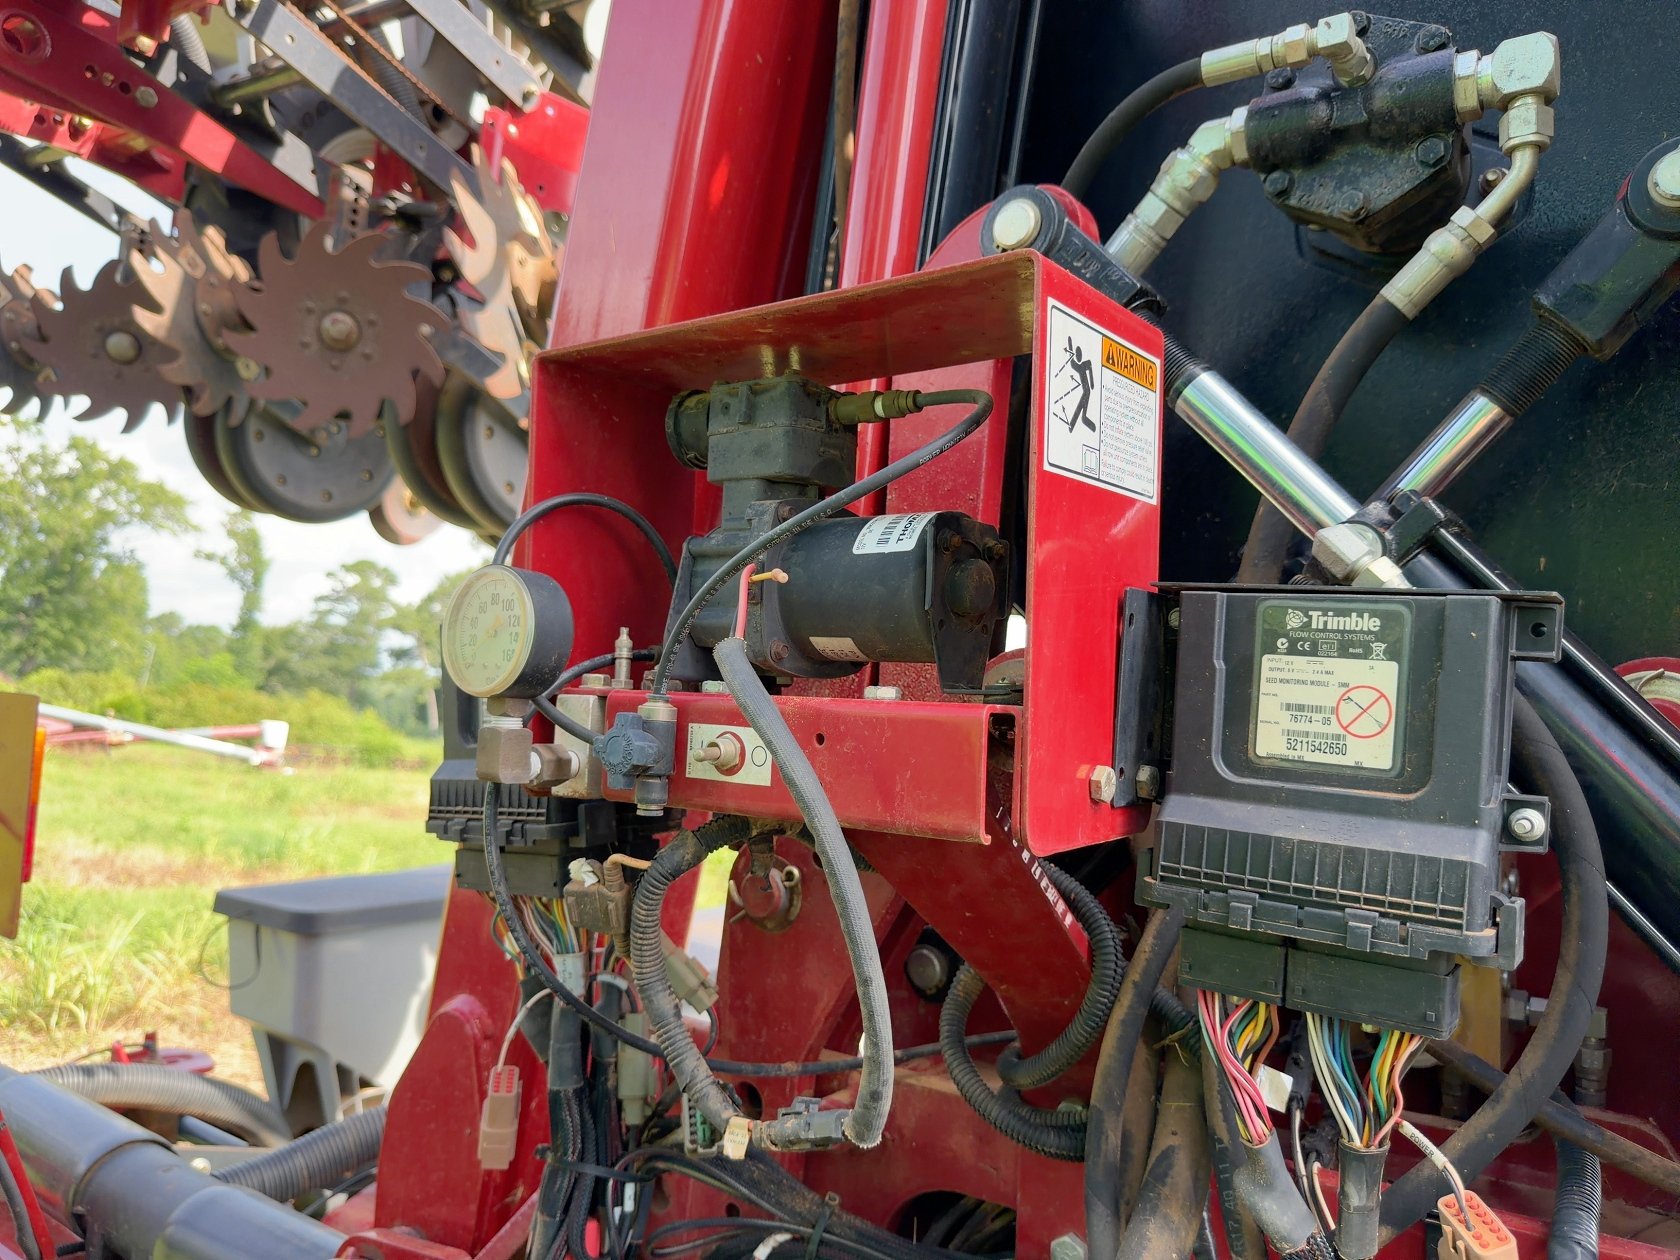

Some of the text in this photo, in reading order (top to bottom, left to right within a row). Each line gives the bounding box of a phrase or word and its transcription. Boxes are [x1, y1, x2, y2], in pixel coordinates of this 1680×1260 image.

[1115, 348, 1154, 387] WARNING
[490, 593, 500, 606] 80
[501, 599, 514, 612] 100
[1308, 610, 1381, 632] Trimble
[1310, 632, 1343, 640] CONTROL
[1344, 633, 1375, 641] SYSTEMS
[1279, 678, 1309, 686] MONITORING
[1286, 738, 1347, 756] 5211542650
[1410, 1132, 1435, 1158] POWER
